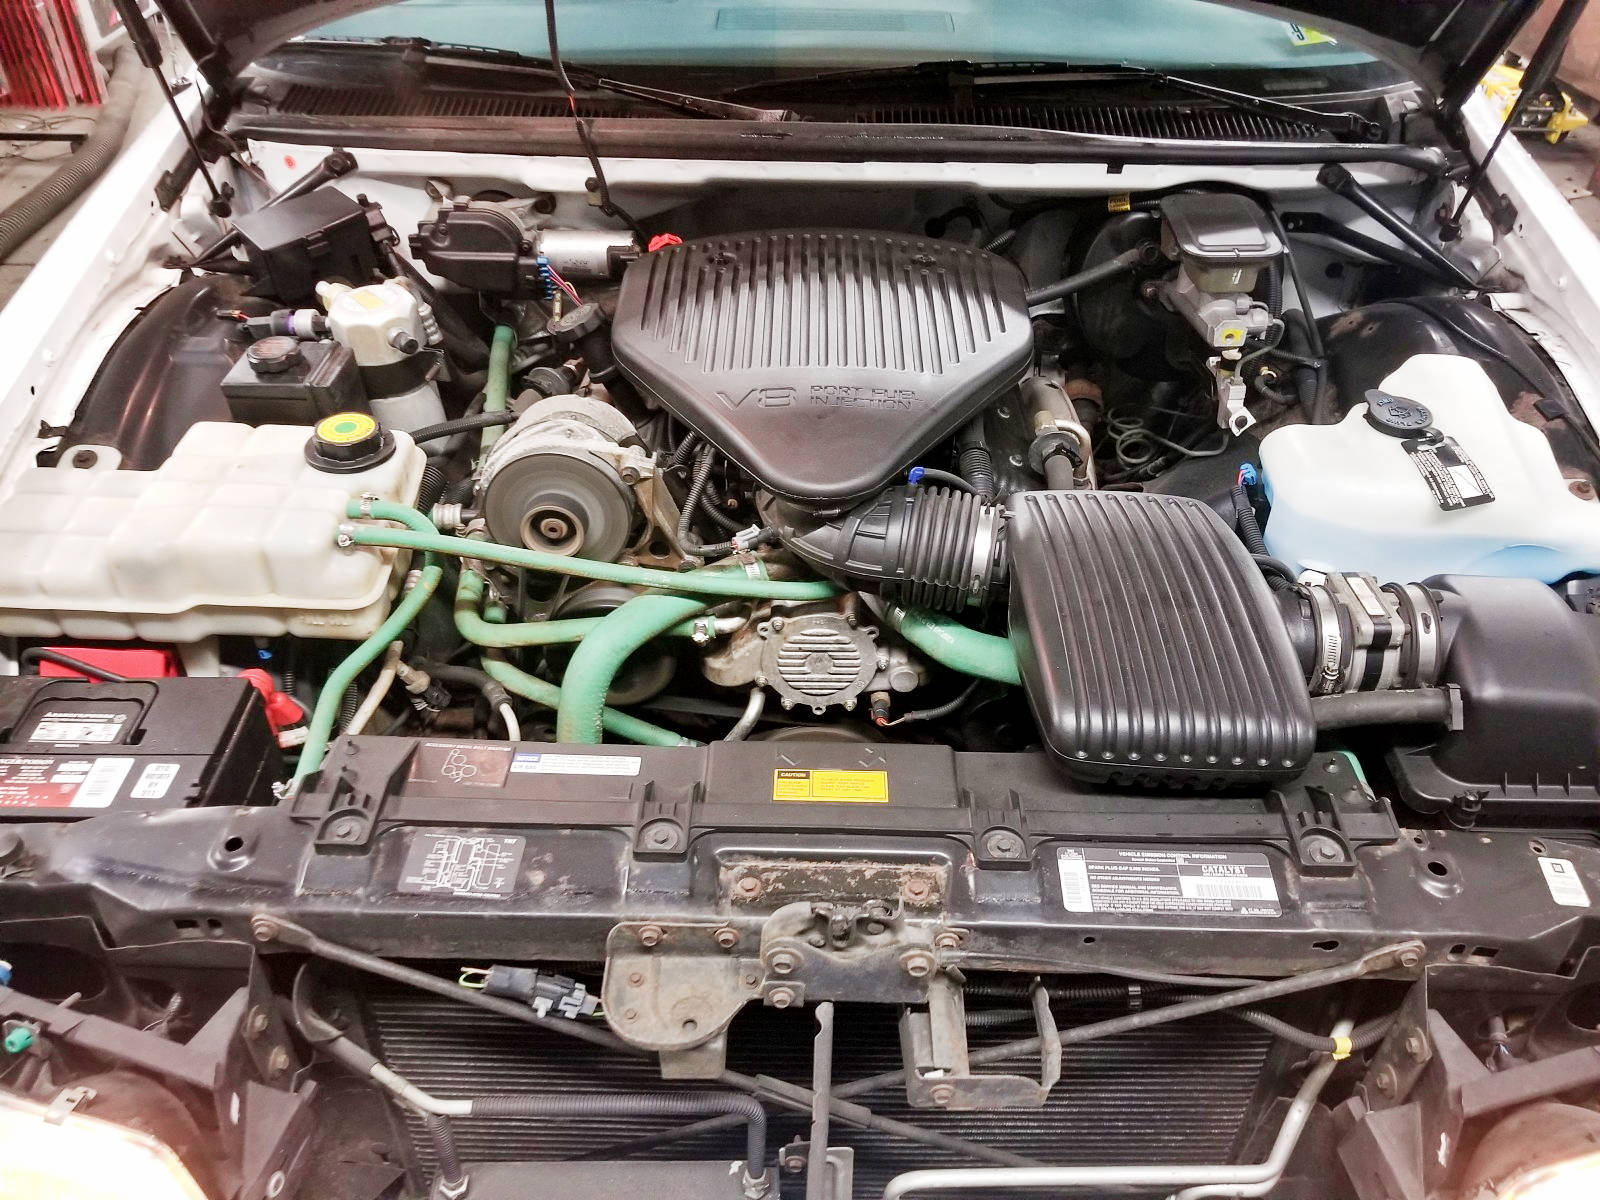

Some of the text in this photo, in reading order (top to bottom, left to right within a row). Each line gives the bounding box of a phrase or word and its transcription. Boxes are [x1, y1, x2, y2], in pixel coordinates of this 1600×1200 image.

[715, 386, 798, 412] V8
[810, 385, 865, 400] PORT
[810, 396, 913, 410] INJECTION
[1191, 853, 1227, 861] INFORMATION
[1201, 865, 1246, 875] CATALYST
